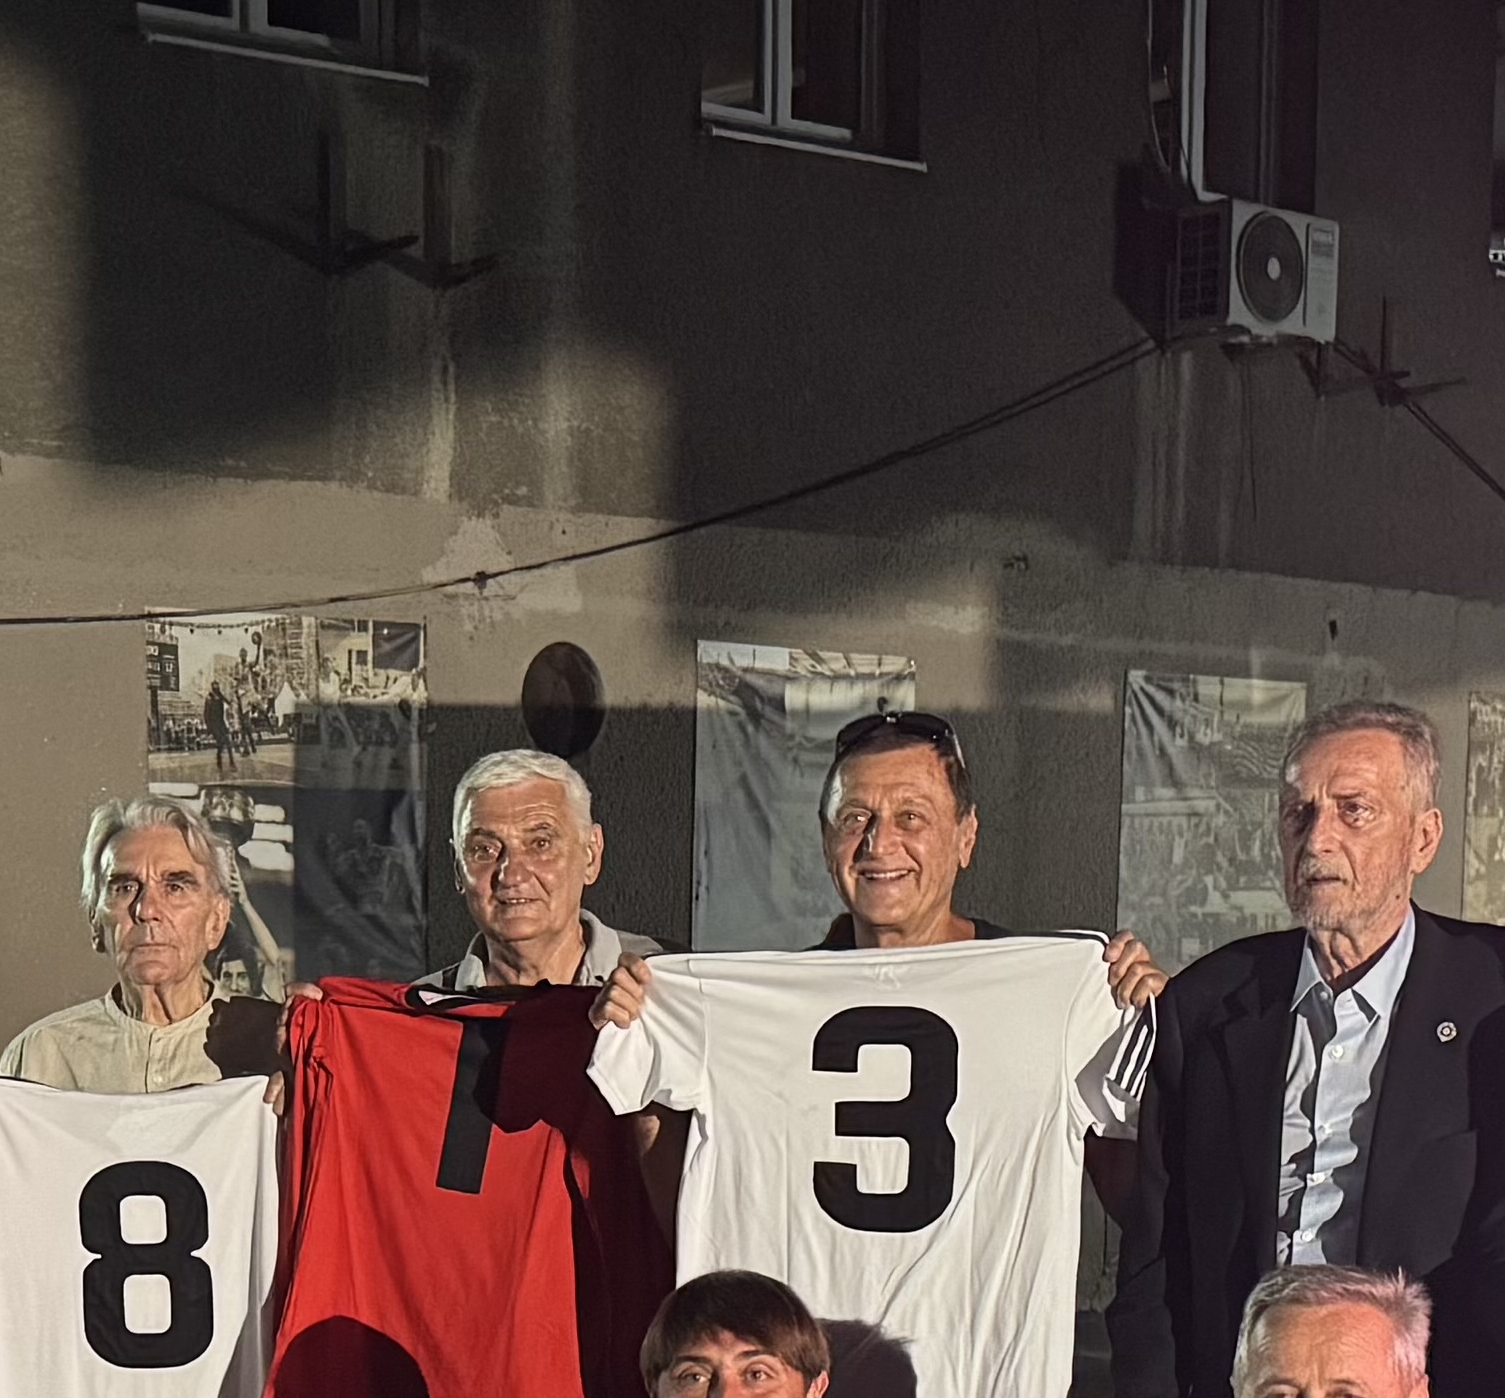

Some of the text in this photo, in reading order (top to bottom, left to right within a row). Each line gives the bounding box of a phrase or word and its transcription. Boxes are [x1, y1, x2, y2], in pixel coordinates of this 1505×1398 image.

[436, 1017, 509, 1194] 1
[811, 1005, 959, 1234] 3
[79, 1160, 214, 1370] 8
